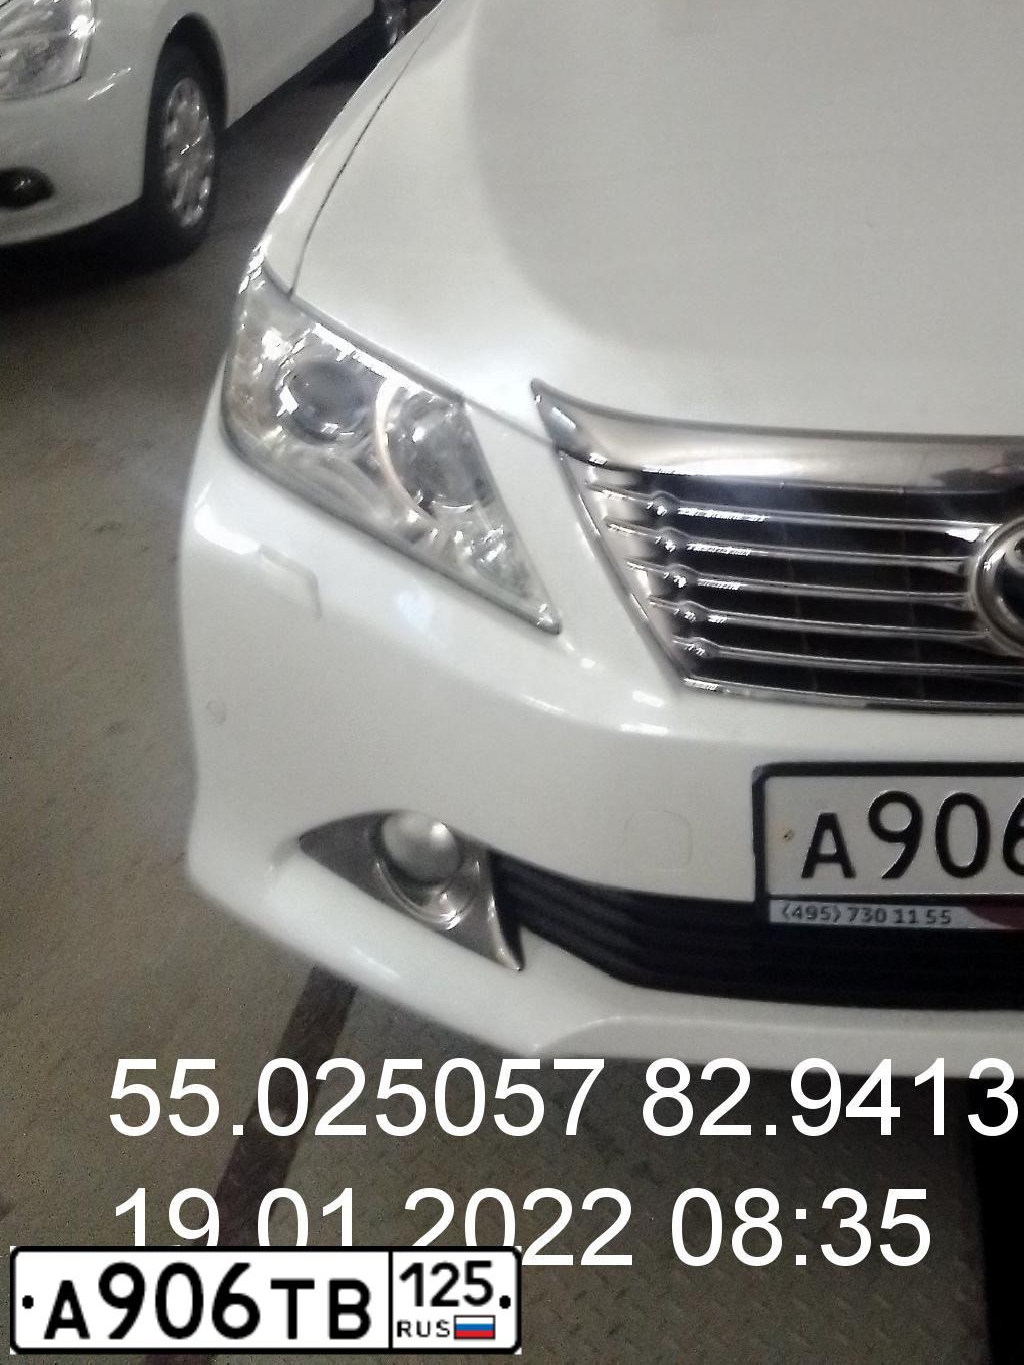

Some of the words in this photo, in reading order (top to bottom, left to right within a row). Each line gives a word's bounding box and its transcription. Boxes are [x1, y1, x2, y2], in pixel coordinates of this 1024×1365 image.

[781, 904, 842, 924] (495)
[848, 906, 888, 925] 730
[894, 906, 917, 925] 11
[925, 907, 952, 926] 55
